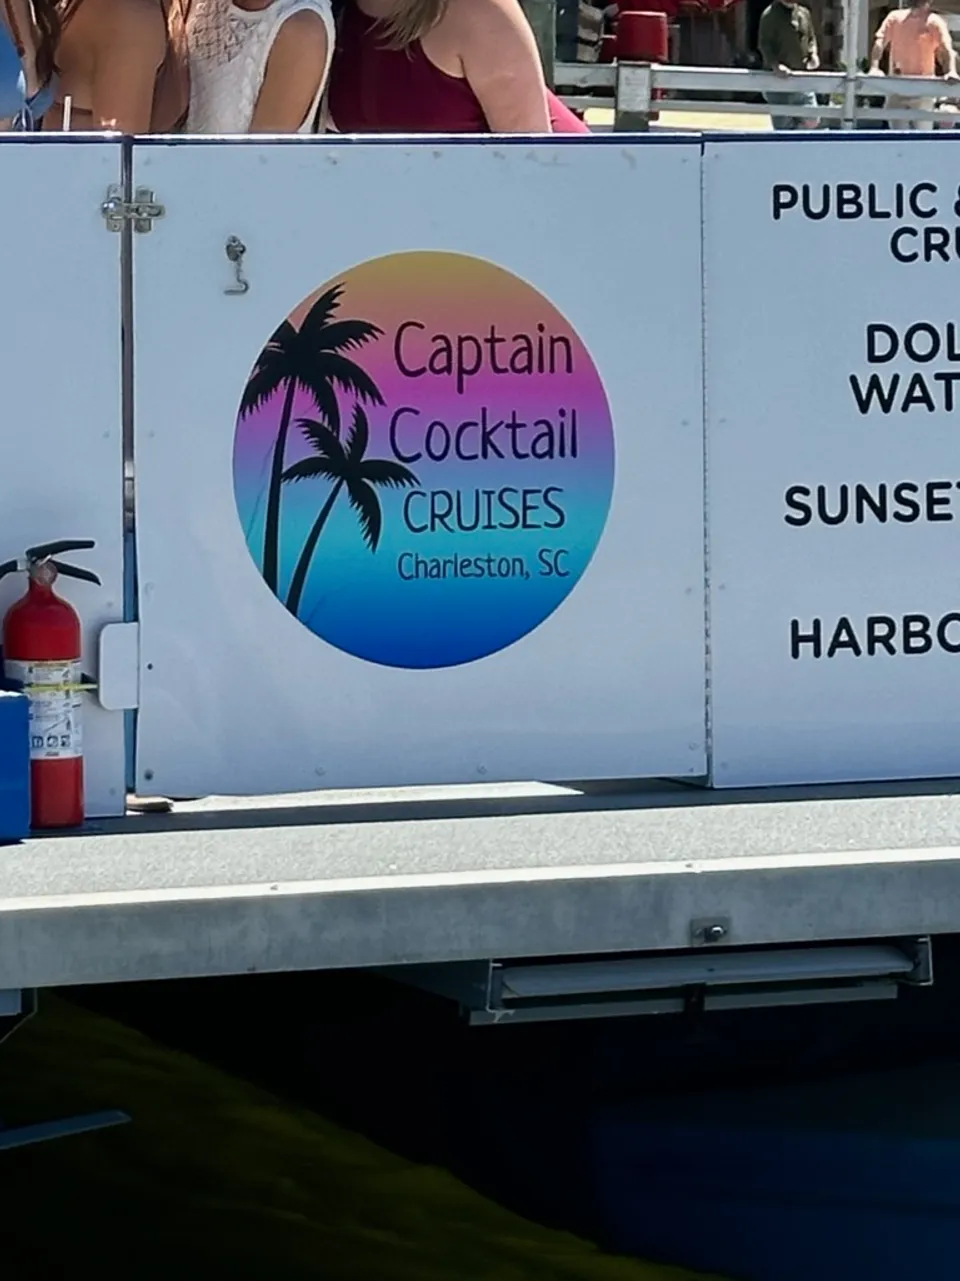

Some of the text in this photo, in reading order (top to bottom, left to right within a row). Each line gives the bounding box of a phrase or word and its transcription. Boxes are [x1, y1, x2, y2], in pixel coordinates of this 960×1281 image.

[772, 182, 938, 220] PUBLIC
[890, 226, 960, 263] CR
[394, 320, 574, 395] Captain
[849, 372, 960, 415] WAT
[389, 406, 579, 464] Cocktail
[402, 486, 566, 534] CRUISES
[784, 481, 960, 527] SUNSE
[397, 549, 571, 580] Charleston, SC
